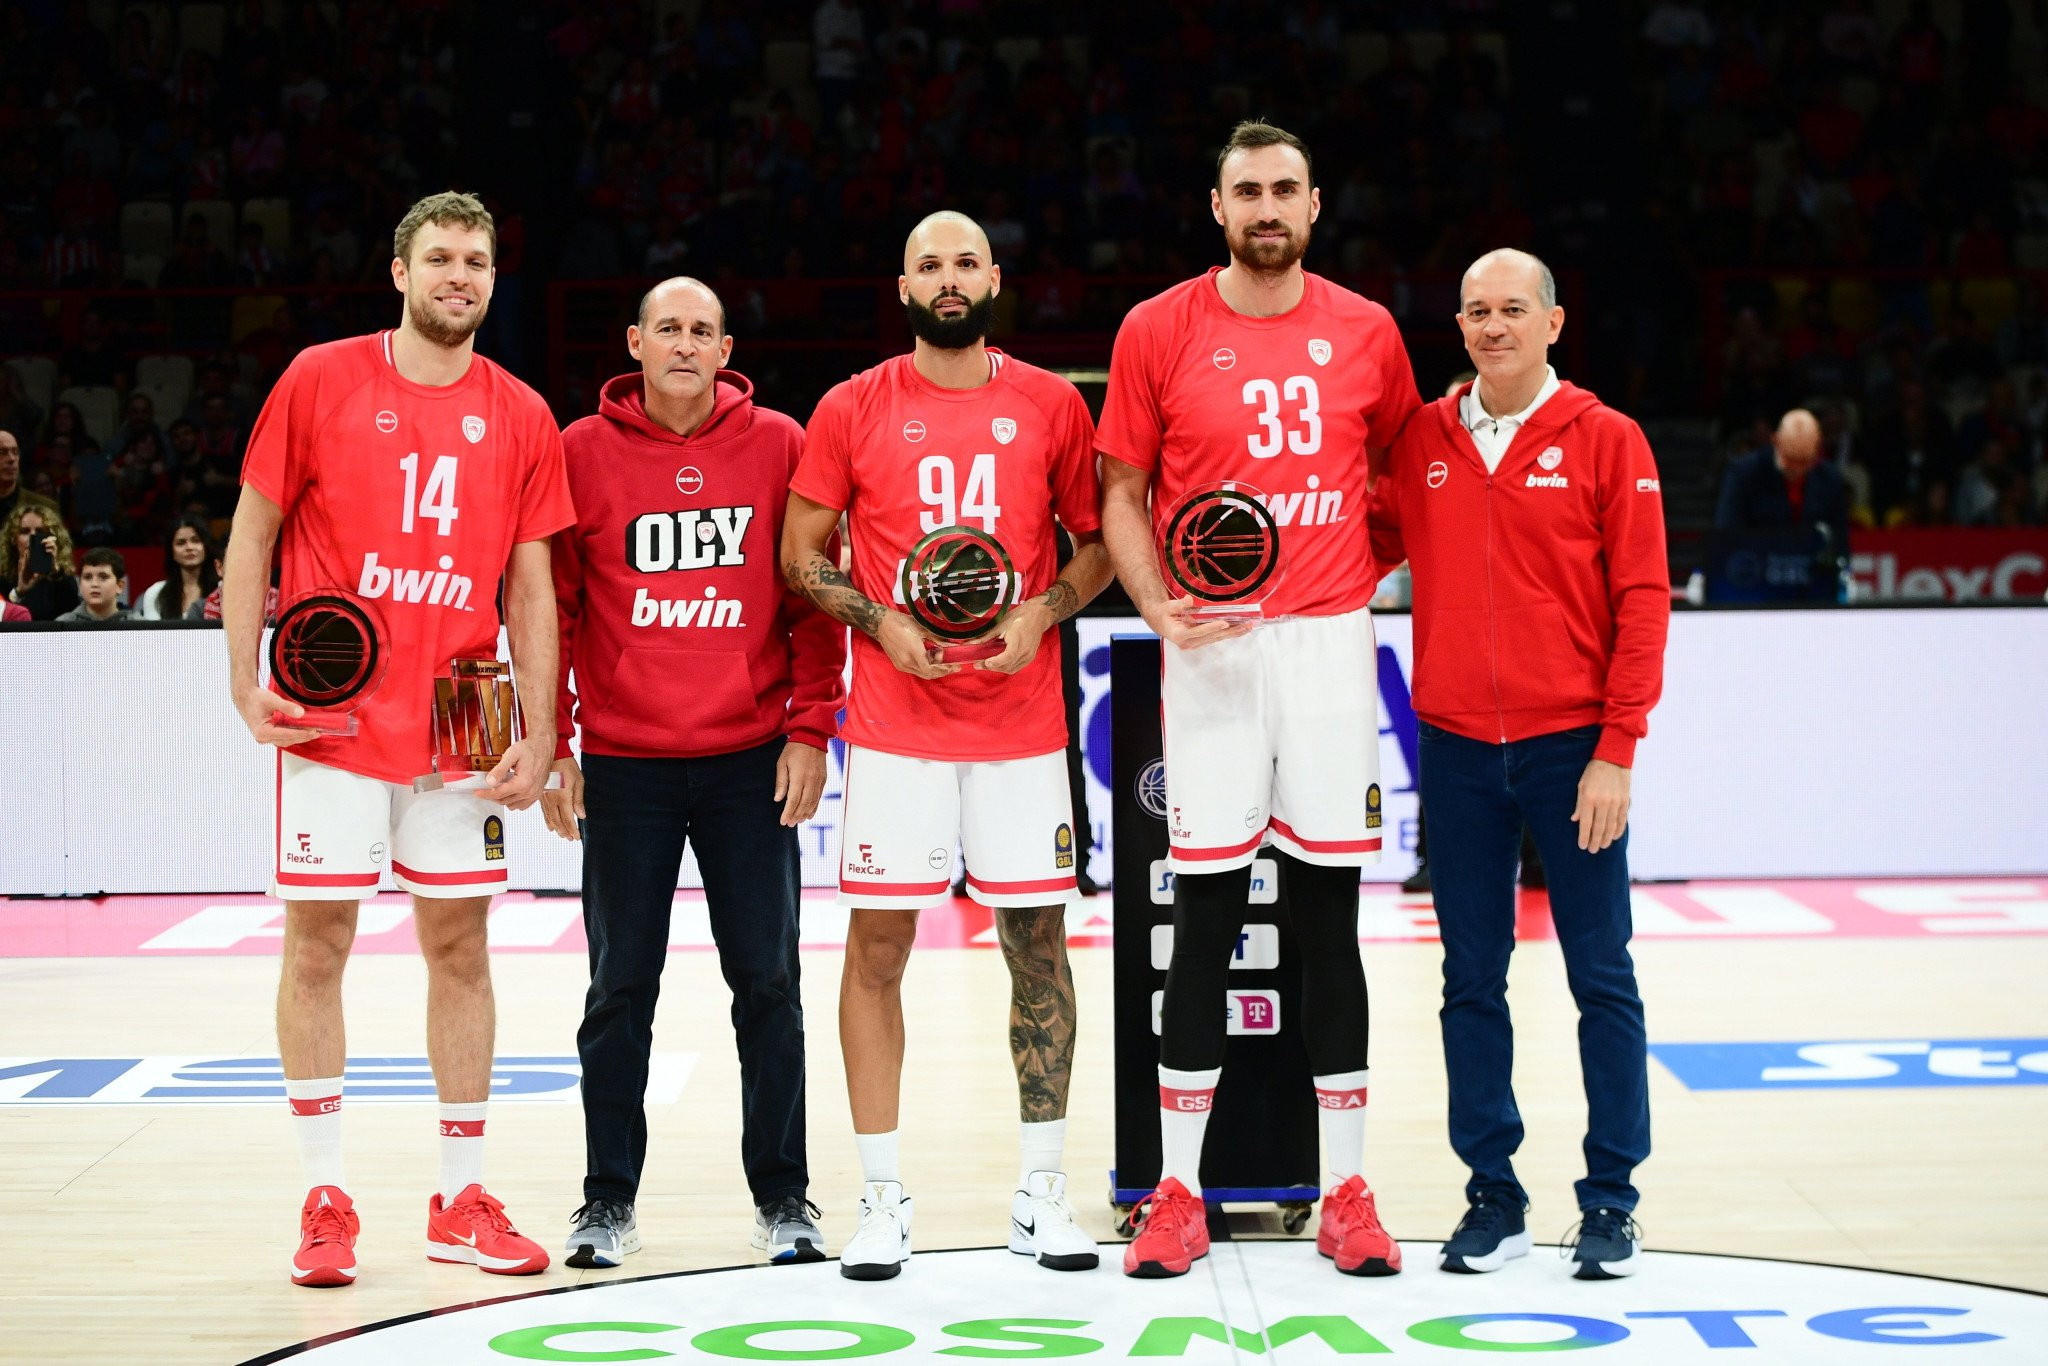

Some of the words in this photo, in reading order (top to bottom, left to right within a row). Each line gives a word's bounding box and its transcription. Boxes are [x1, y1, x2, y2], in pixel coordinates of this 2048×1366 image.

[1243, 376, 1322, 459] 33
[400, 452, 458, 536] 14
[918, 454, 1001, 534] 94
[1525, 472, 1568, 488] bwin
[628, 506, 754, 574] OLY
[357, 552, 473, 610] bwin
[631, 586, 743, 627] bwin
[286, 852, 324, 865] FlexCar
[486, 848, 504, 859] GBL
[848, 862, 886, 875] FlexCar
[488, 1306, 2007, 1362] COSMOTE
